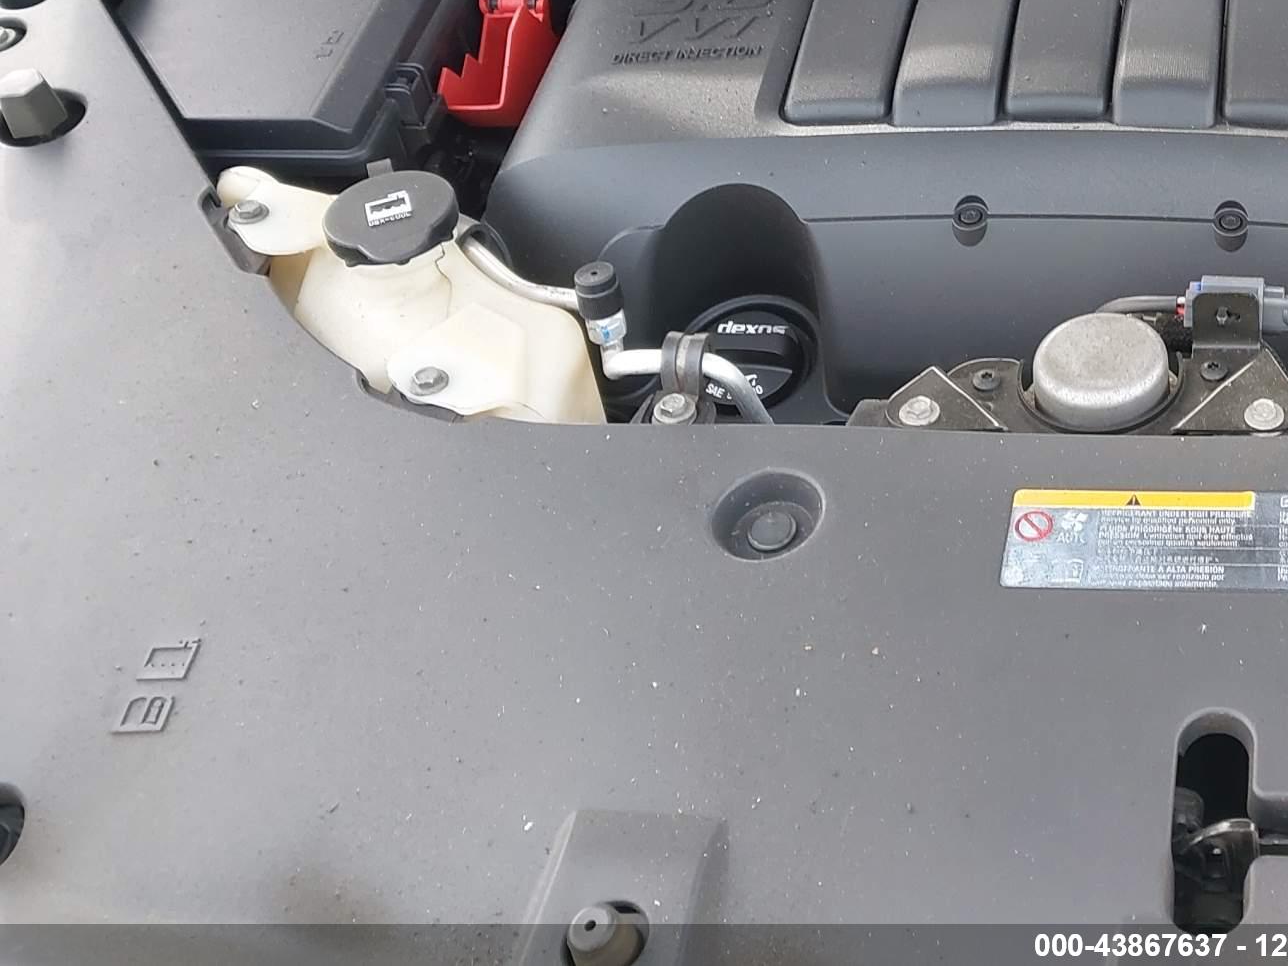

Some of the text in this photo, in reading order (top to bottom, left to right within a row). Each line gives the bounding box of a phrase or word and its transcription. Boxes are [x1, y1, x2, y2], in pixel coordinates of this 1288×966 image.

[611, 45, 764, 65] DIRECT INJECTION
[705, 382, 726, 400] SAE
[1158, 510, 1186, 518] UNDER
[1188, 510, 1208, 518] HIGH
[1209, 510, 1252, 518] PRESSURE
[1143, 517, 1177, 525] qualified
[1178, 517, 1217, 525] personnel
[1209, 525, 1236, 534] HAUTE
[1166, 565, 1186, 574] ALTA
[1172, 573, 1209, 581] realizado
[1210, 573, 1225, 581] por
